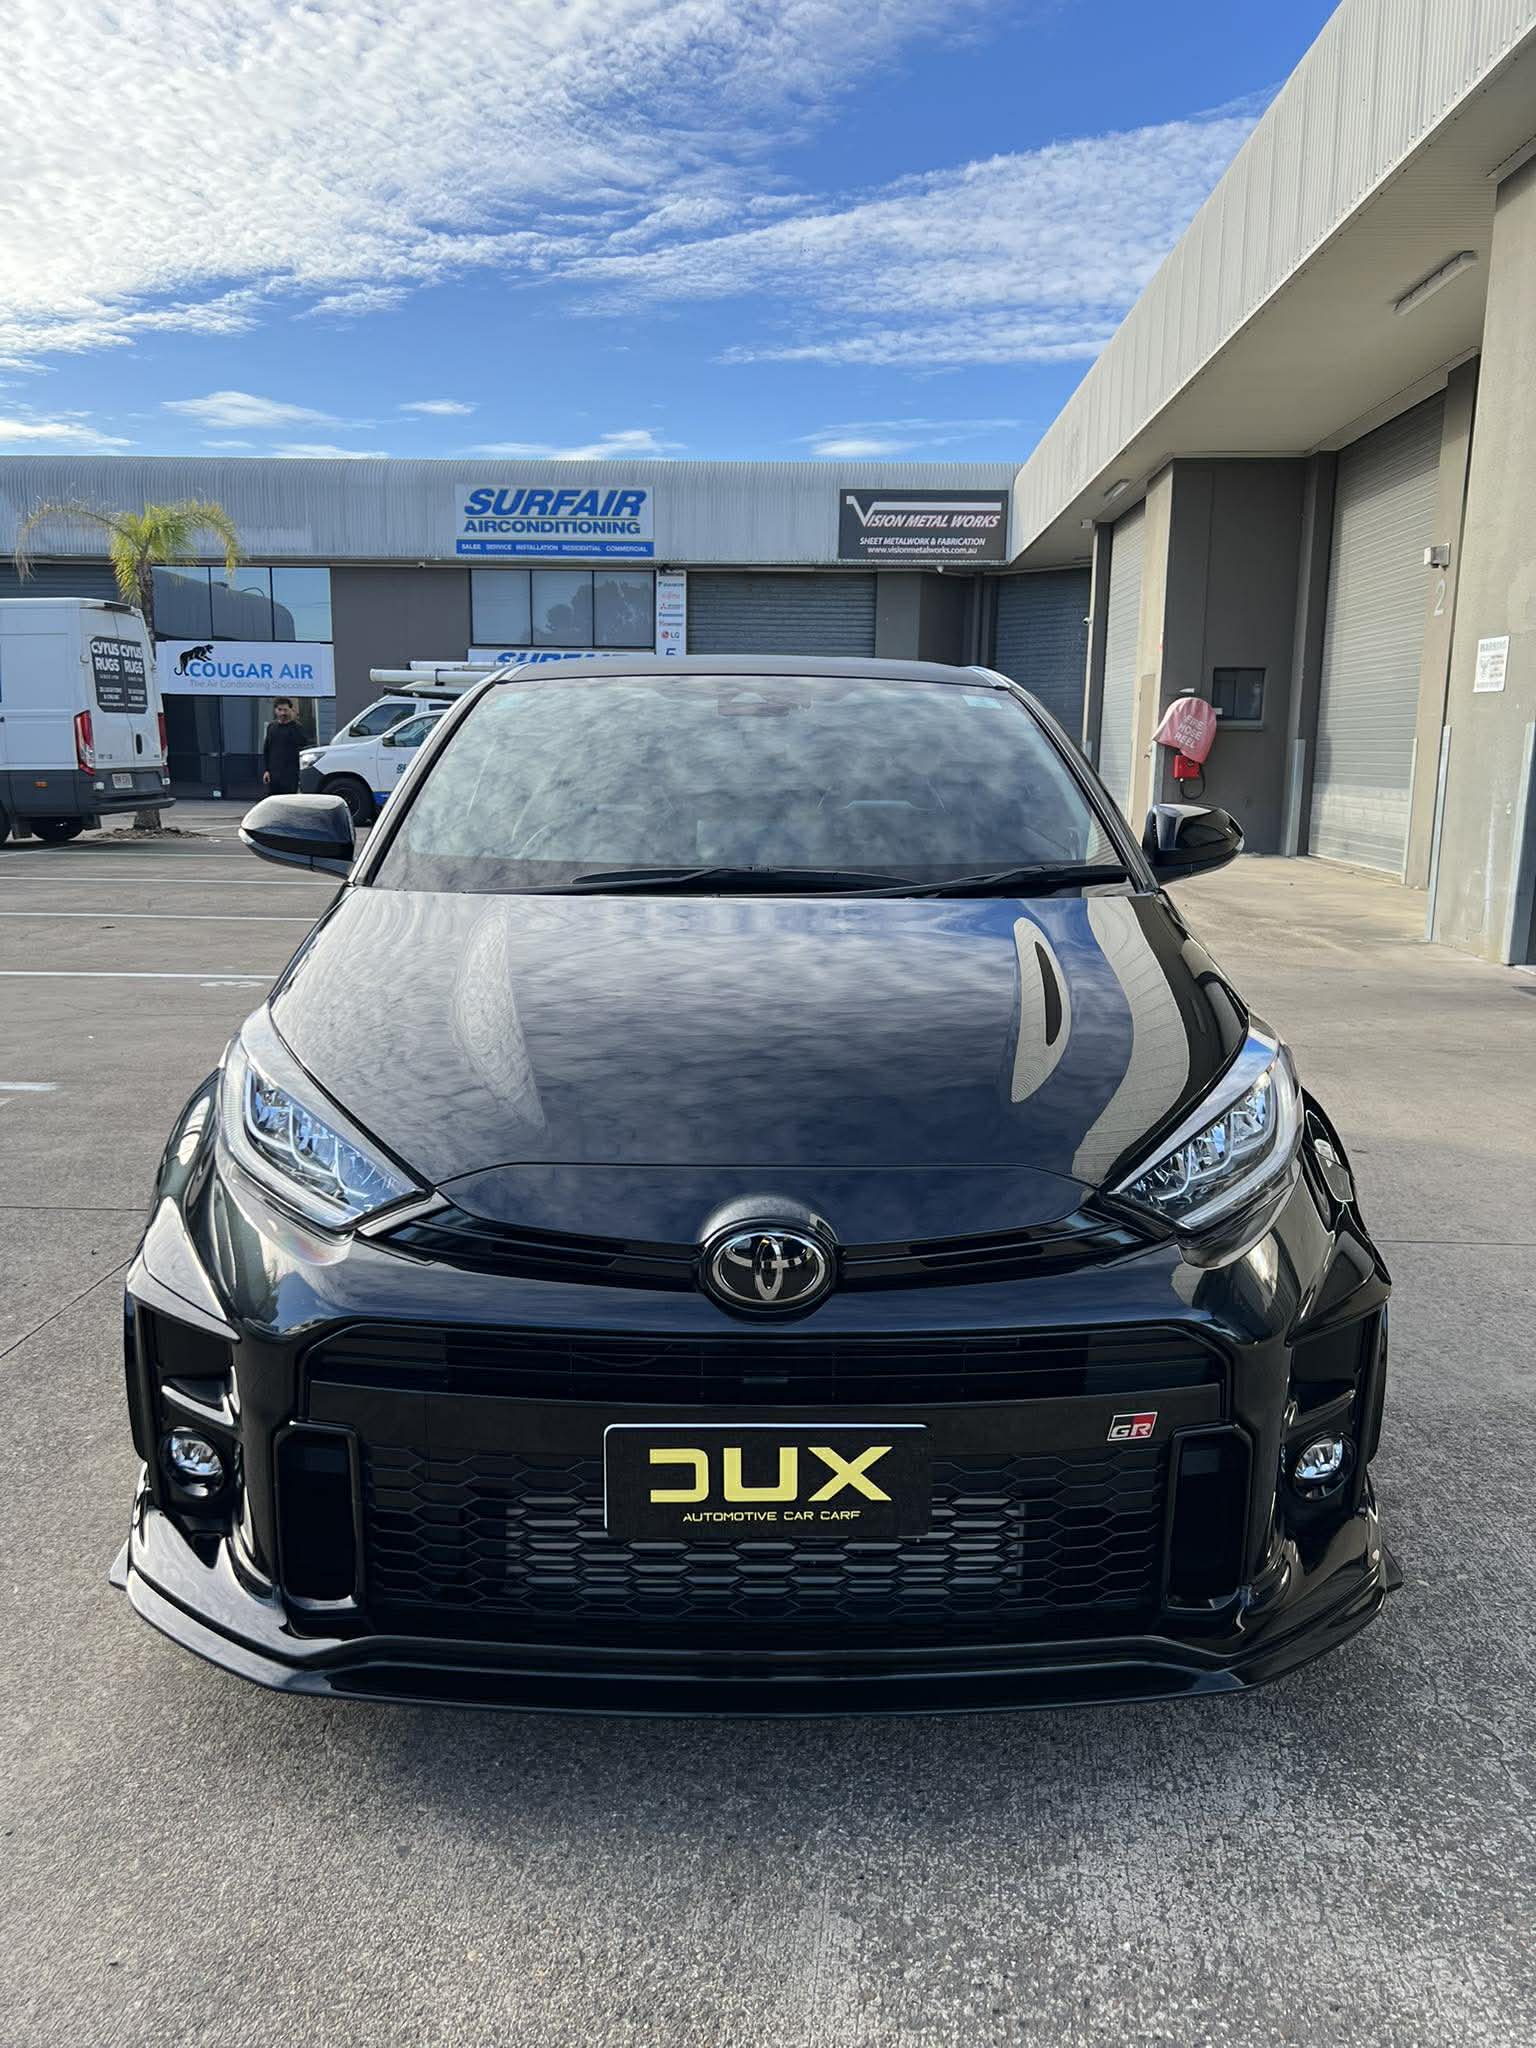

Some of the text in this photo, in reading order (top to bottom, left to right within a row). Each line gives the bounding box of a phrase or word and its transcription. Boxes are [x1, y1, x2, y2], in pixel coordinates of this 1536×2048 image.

[464, 488, 647, 517] SURFAIR
[463, 519, 641, 535] AIRCONDITIONING
[904, 514, 950, 528] METAL
[950, 515, 1000, 528] WORKS
[461, 543, 481, 551] SALES
[486, 543, 512, 551] SERVICE
[562, 544, 602, 552] RESIDENTIAL
[606, 544, 648, 553] COMMERCIAL
[859, 536, 986, 546] SHEET METALWORK & FABRICATION
[867, 545, 978, 554] www.visionmetalworks.com.au
[1434, 578, 1446, 617] 2
[95, 656, 120, 672] RUGS
[124, 660, 144, 674] RUGS
[189, 661, 313, 680] COUGAR AIR
[190, 680, 206, 688] The
[207, 681, 219, 689] Air
[221, 681, 270, 690] Conditioning
[1174, 732, 1195, 748] REEL
[1111, 1423, 1152, 1438] GR
[682, 1511, 777, 1522] AUTOMOTIVE
[783, 1511, 814, 1521] CAR
